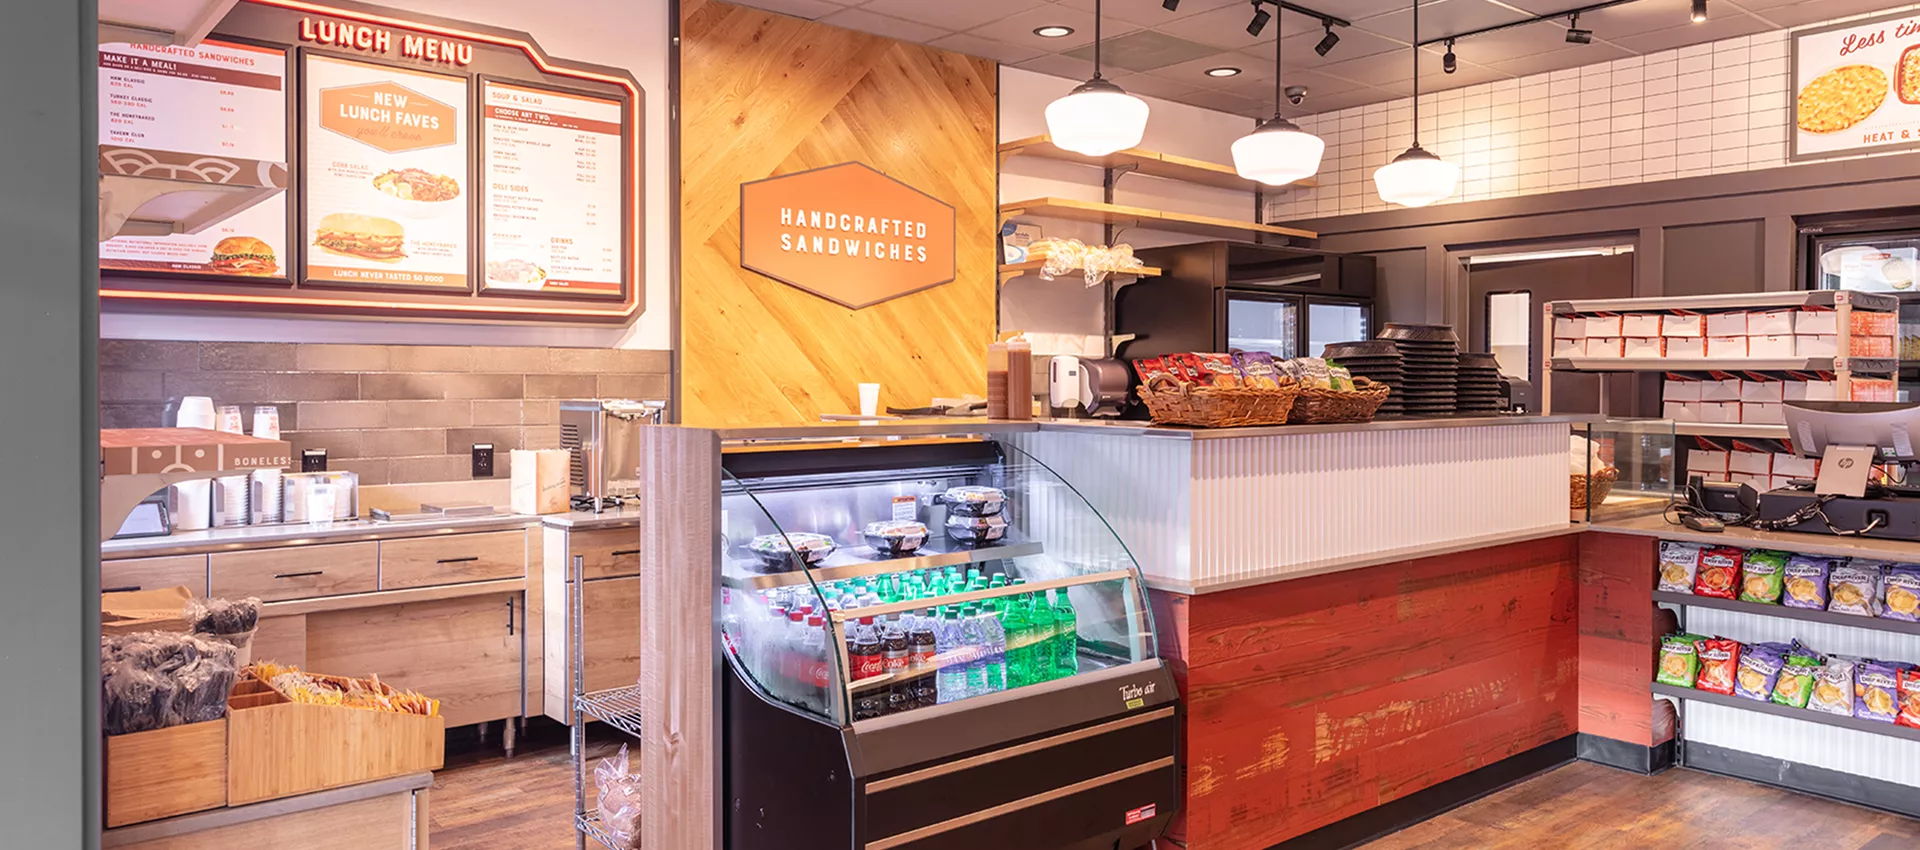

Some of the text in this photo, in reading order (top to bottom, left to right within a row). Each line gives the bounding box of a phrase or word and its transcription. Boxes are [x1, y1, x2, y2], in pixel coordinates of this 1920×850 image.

[300, 17, 472, 64] LUNCH MENU
[1840, 30, 1885, 56] Less
[103, 54, 127, 64] MAKE
[152, 60, 177, 70] MEAL!
[130, 42, 255, 66] HANDCRAFTED SANDWICHES
[374, 92, 408, 108] NEW
[339, 104, 440, 129] LUNCH FAVES
[495, 107, 519, 116] CHOOSE
[1863, 129, 1910, 143] HEAT &
[780, 208, 926, 239] HANDCRAFTED
[780, 234, 927, 262] SANDWICHES
[360, 271, 383, 279] NEVER
[385, 272, 411, 280] TASTED
[1119, 681, 1155, 701] Turbo air
